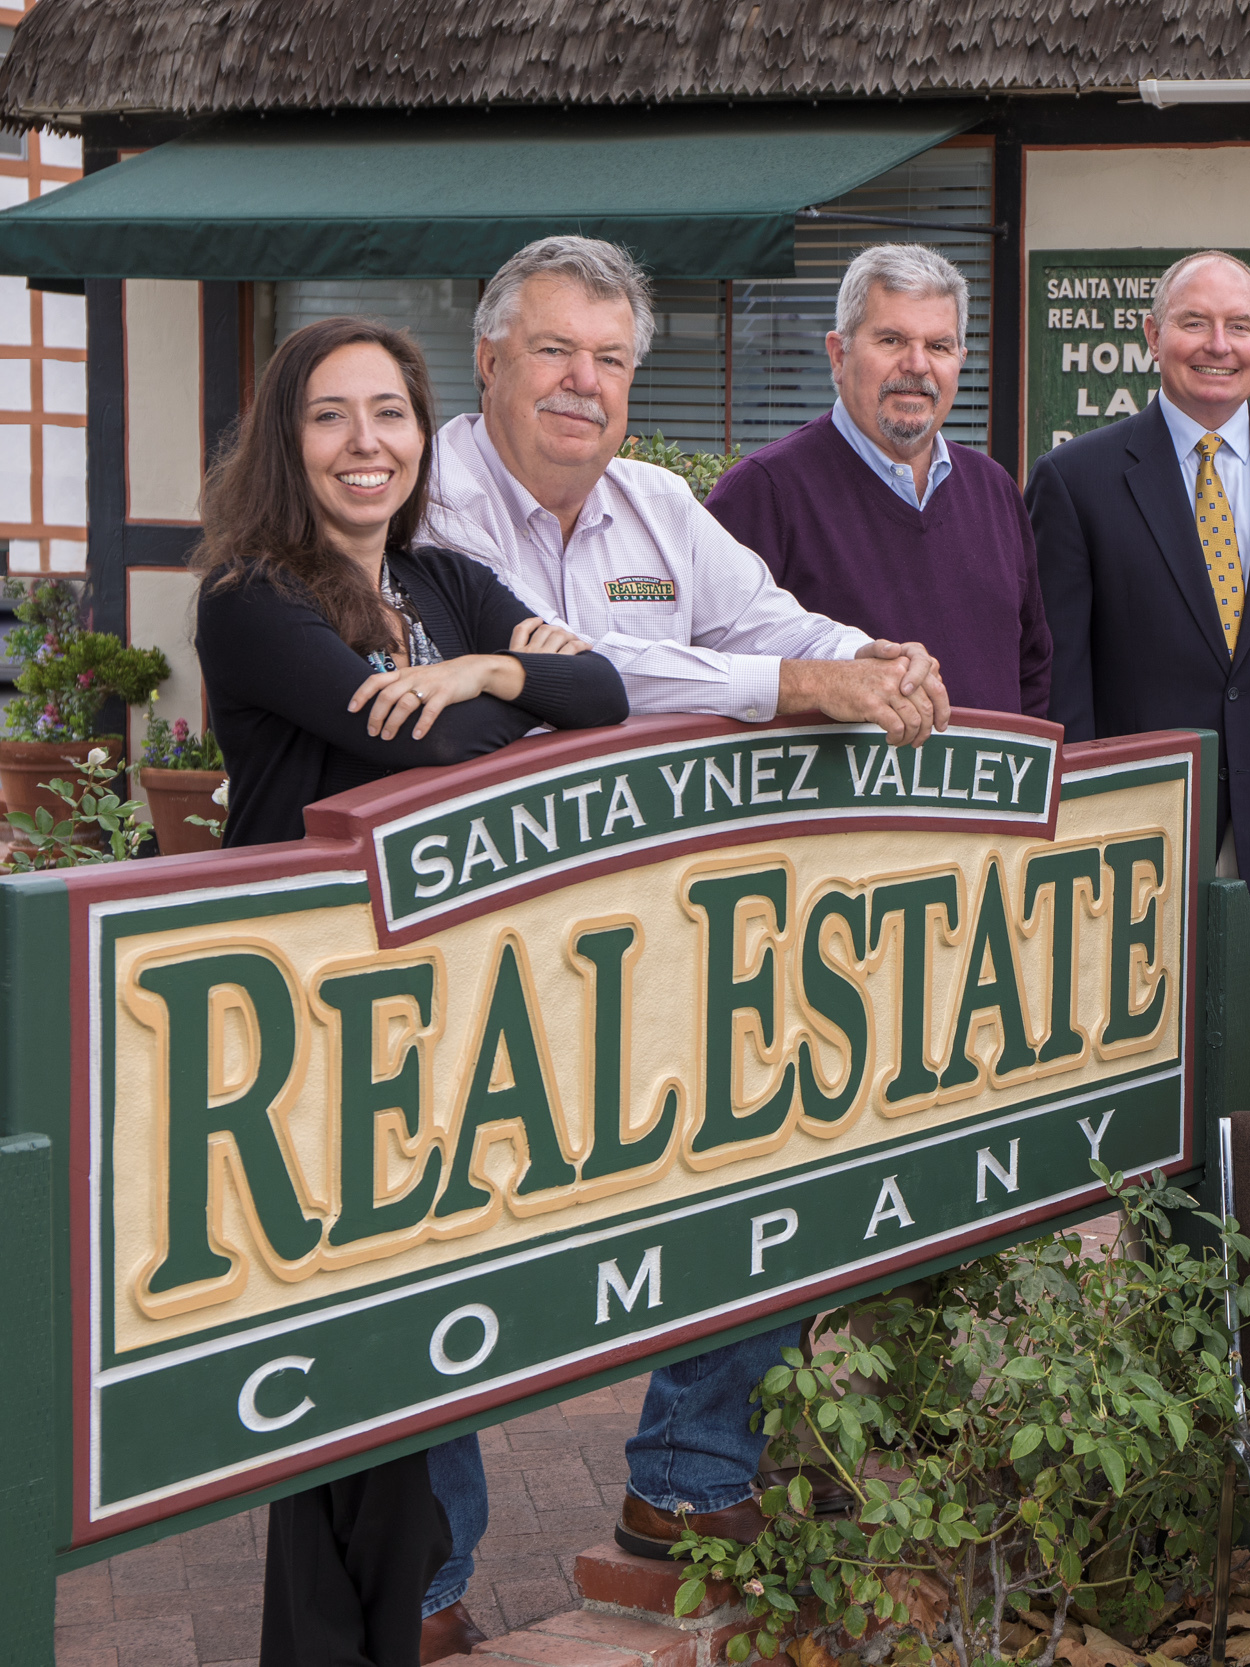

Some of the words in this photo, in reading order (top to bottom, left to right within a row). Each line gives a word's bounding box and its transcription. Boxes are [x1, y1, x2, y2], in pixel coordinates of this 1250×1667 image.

[1047, 277, 1111, 299] SANTA
[1048, 308, 1104, 329] REAL
[1113, 308, 1150, 330] EST
[1062, 342, 1160, 374] HOM
[410, 773, 647, 898] SANTA
[658, 744, 820, 819] YNEZ
[844, 743, 1035, 805] VALLEY
[238, 1109, 1116, 1433] COMPANY
